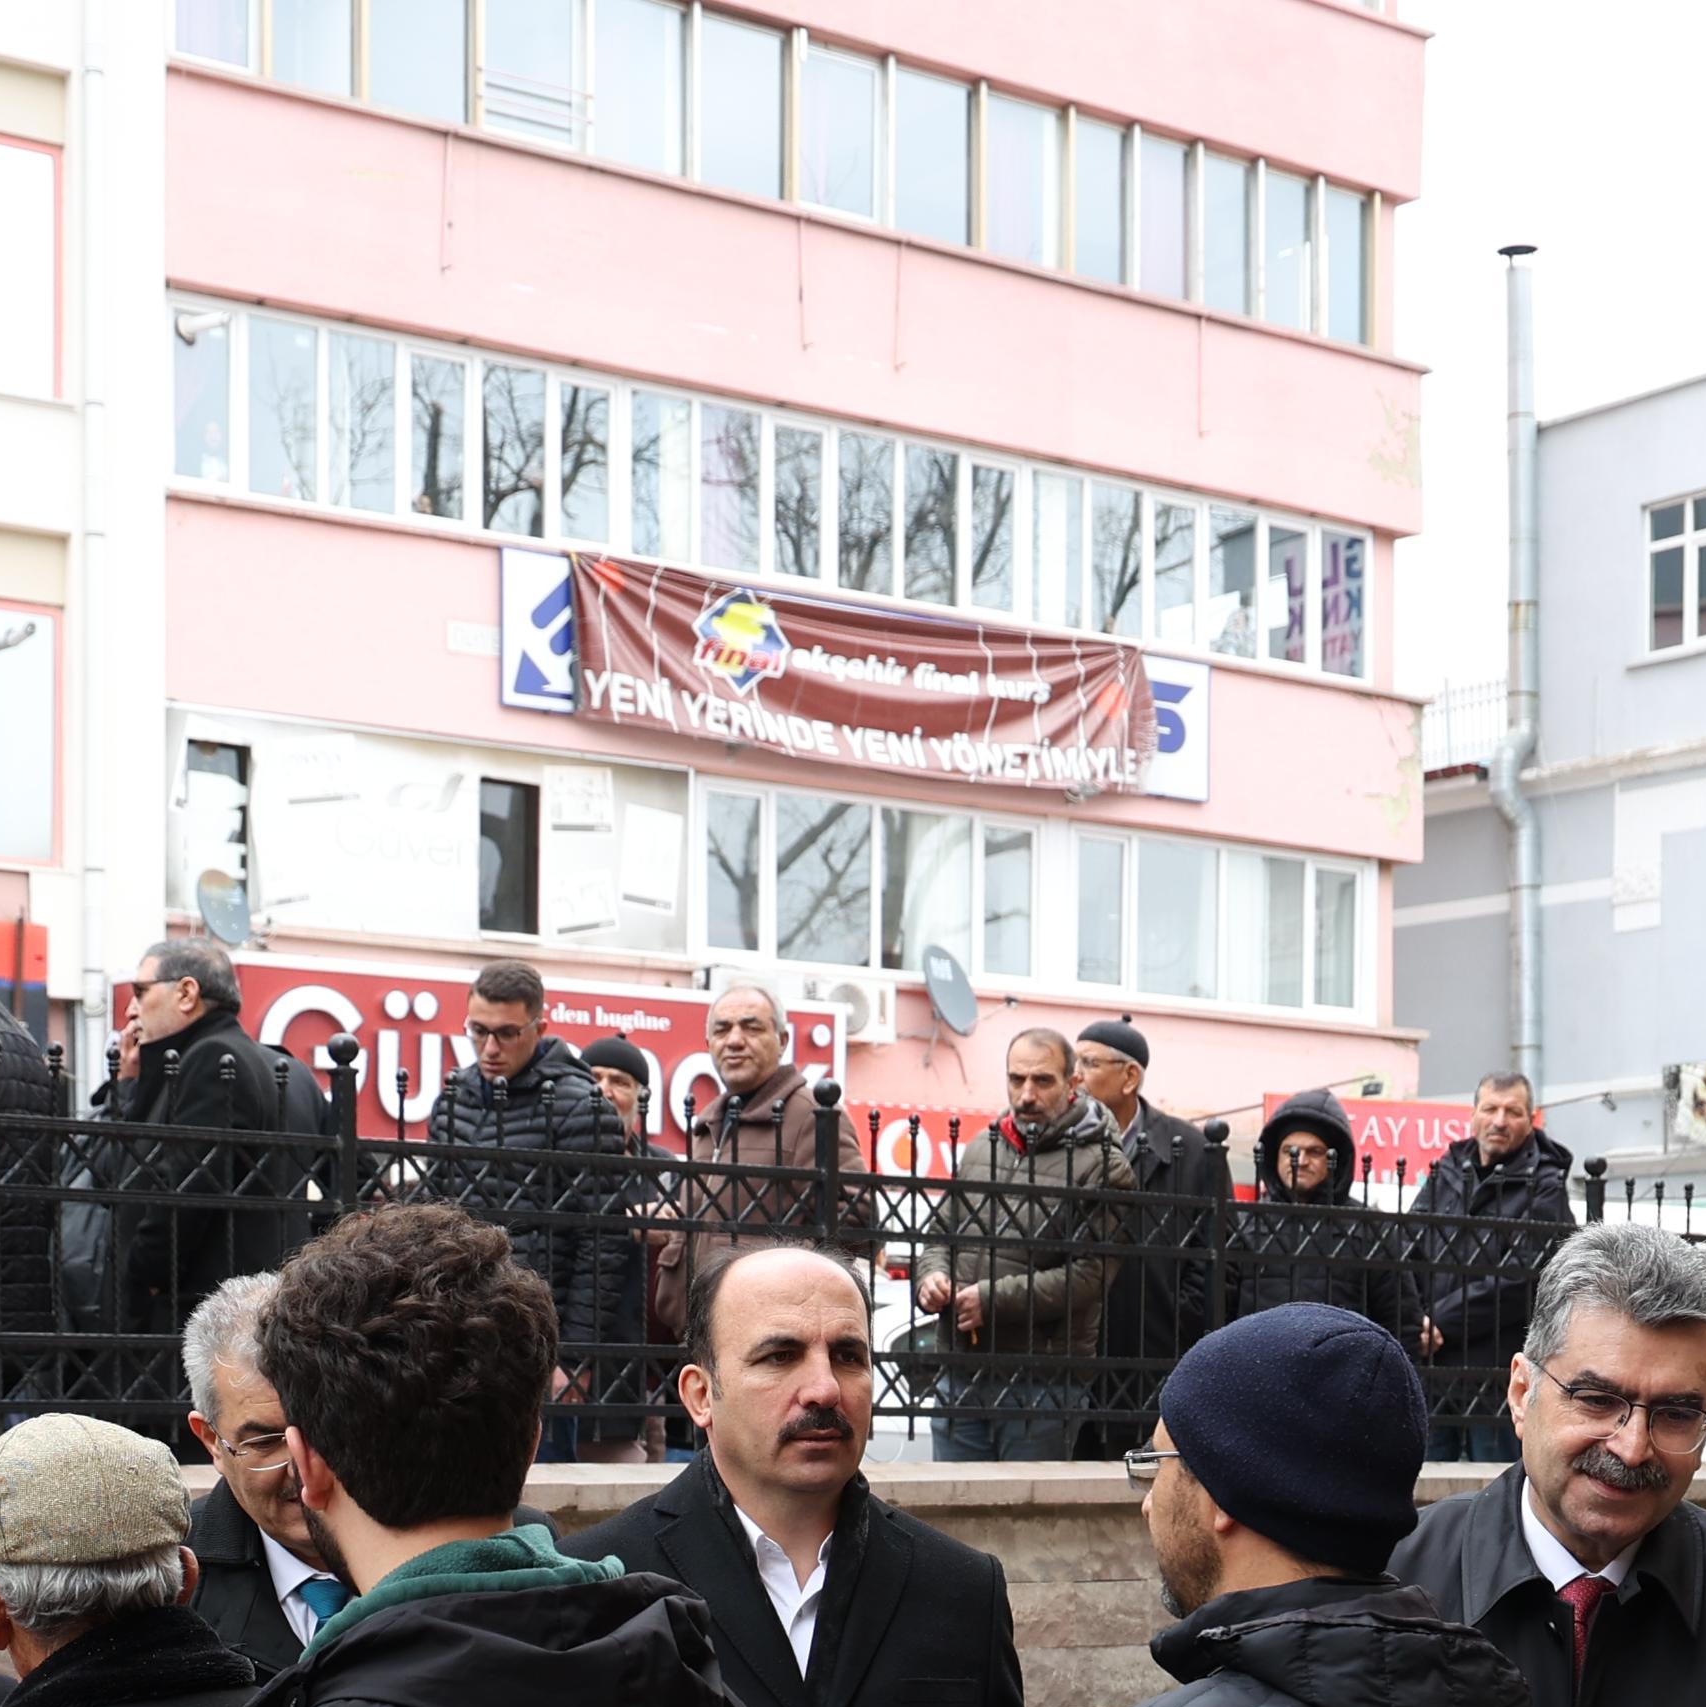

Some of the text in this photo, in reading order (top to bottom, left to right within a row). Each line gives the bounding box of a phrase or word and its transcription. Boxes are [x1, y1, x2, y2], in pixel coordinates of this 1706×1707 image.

[700, 637, 783, 673] final
[791, 646, 1053, 704] akşehir final kurs
[584, 668, 1138, 785] YENİ YERİNDE YENİ YÖNETİMİYLE
[594, 1005, 672, 1035] bugüne
